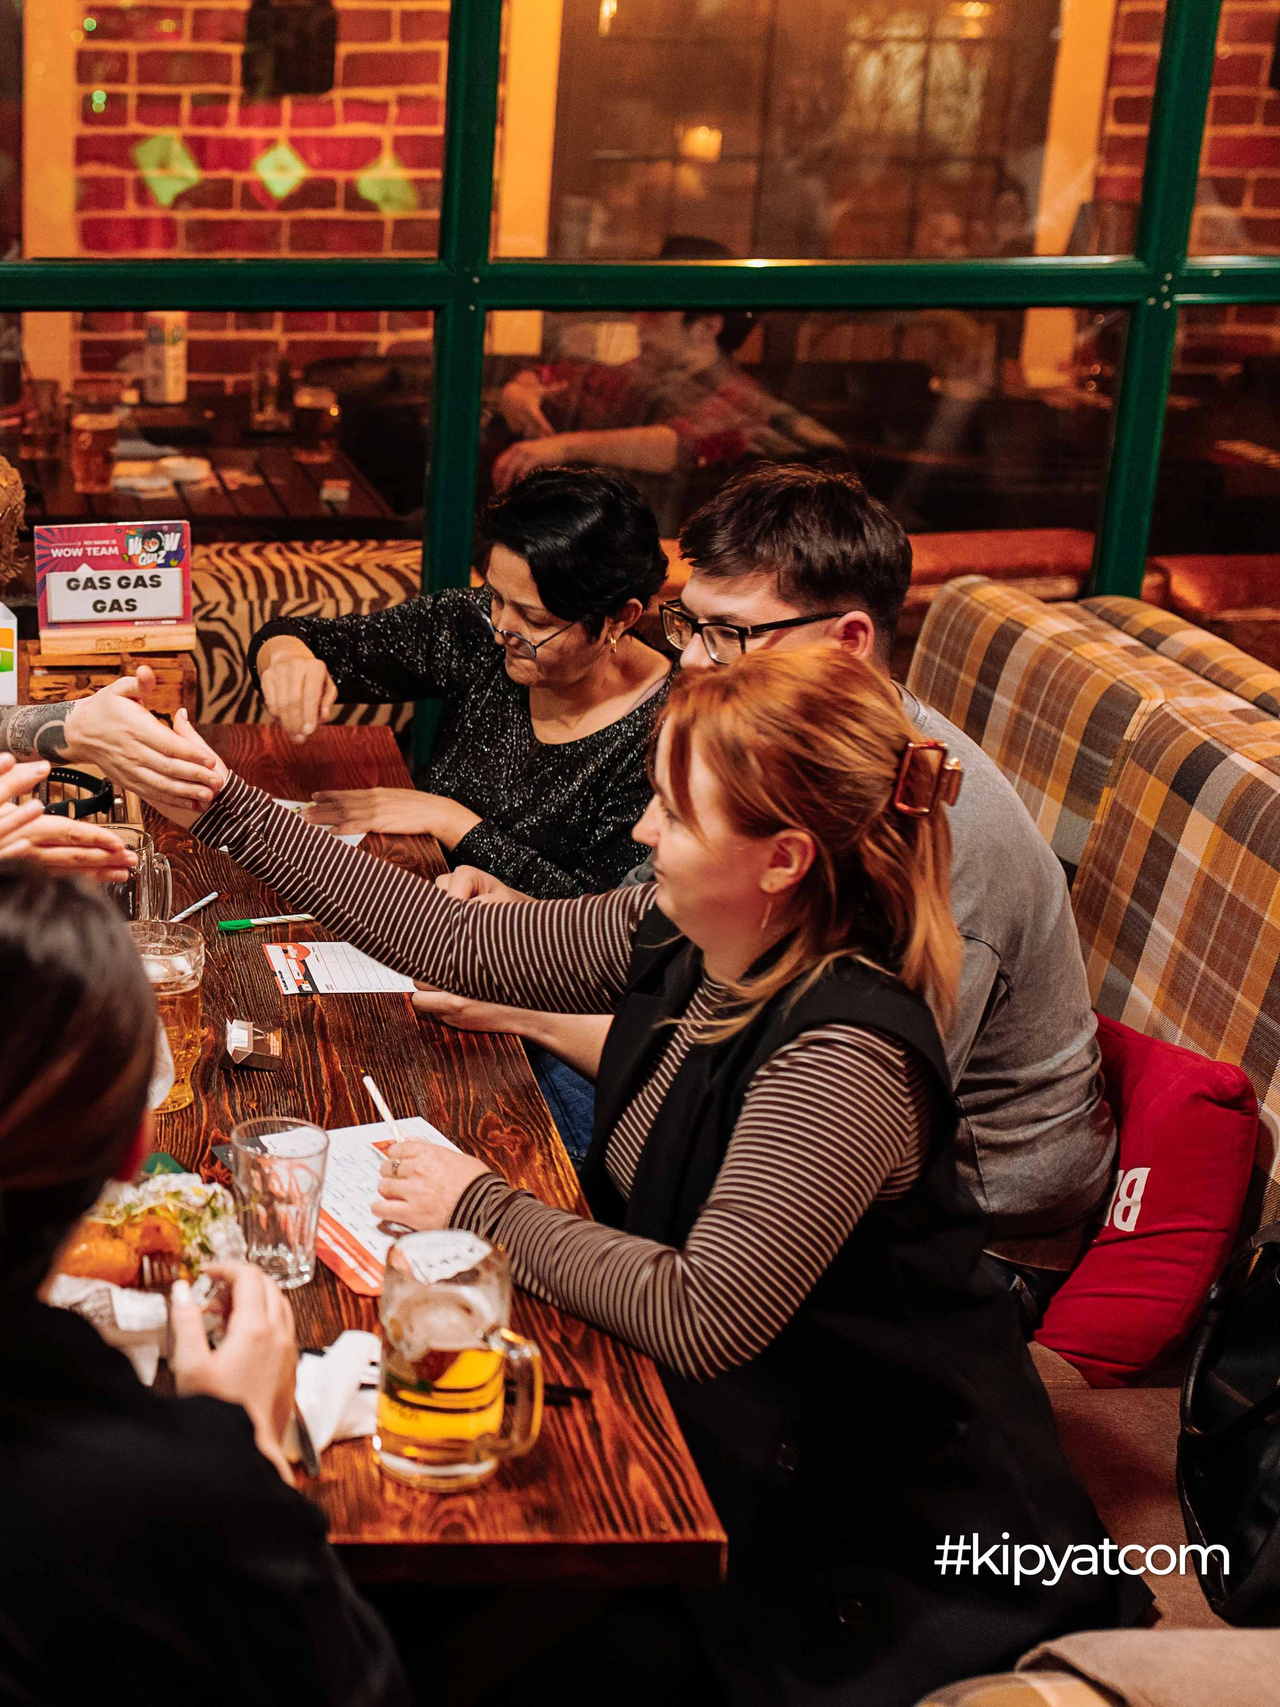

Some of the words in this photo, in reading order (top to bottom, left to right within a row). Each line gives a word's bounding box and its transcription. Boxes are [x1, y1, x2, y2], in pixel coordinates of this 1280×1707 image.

[51, 547, 84, 558] WOW
[85, 546, 119, 557] TEAM
[138, 550, 167, 566] QUIZ
[66, 576, 111, 591] GAS
[117, 574, 162, 589] GAS
[92, 598, 137, 613] GAS
